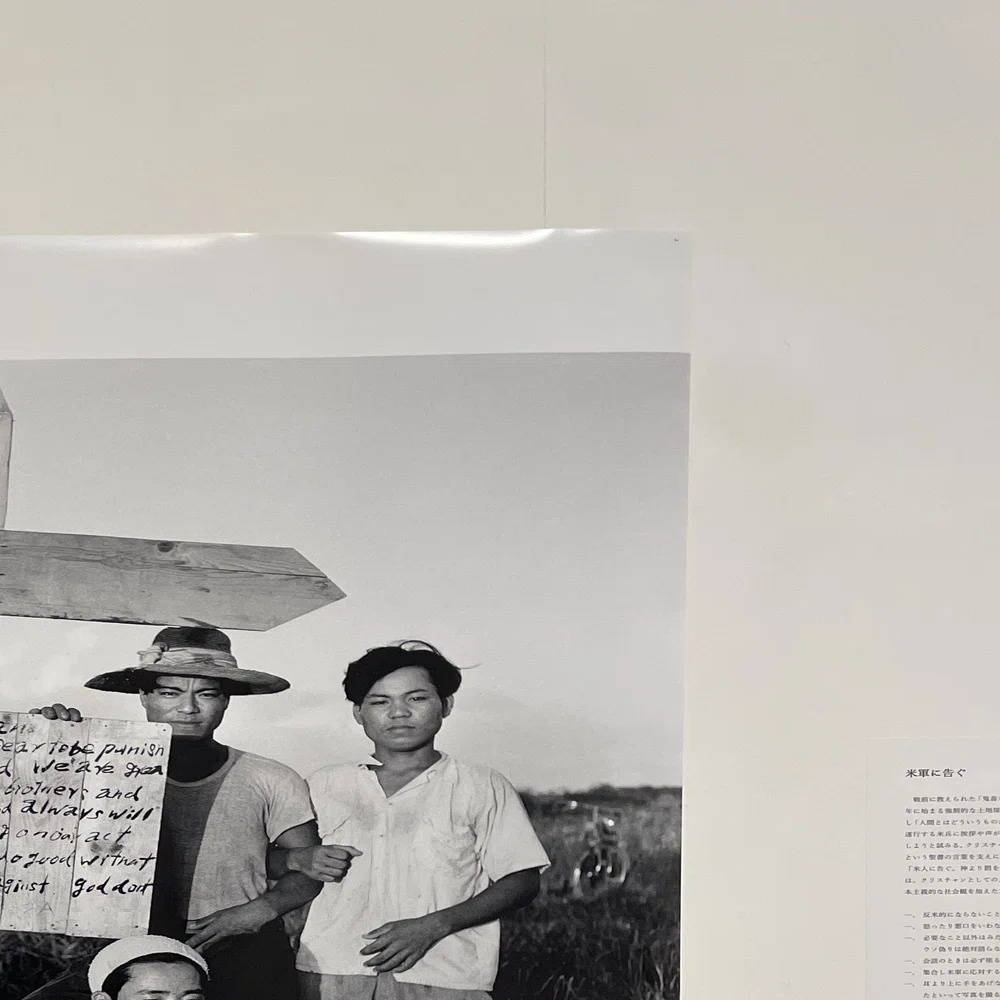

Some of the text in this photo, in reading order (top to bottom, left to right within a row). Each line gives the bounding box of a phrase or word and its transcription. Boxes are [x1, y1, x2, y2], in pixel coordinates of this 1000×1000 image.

[905, 768, 966, 778] 米軍に告ぐ
[95, 785, 143, 801] and
[21, 799, 104, 821] always
[108, 806, 154, 821] will
